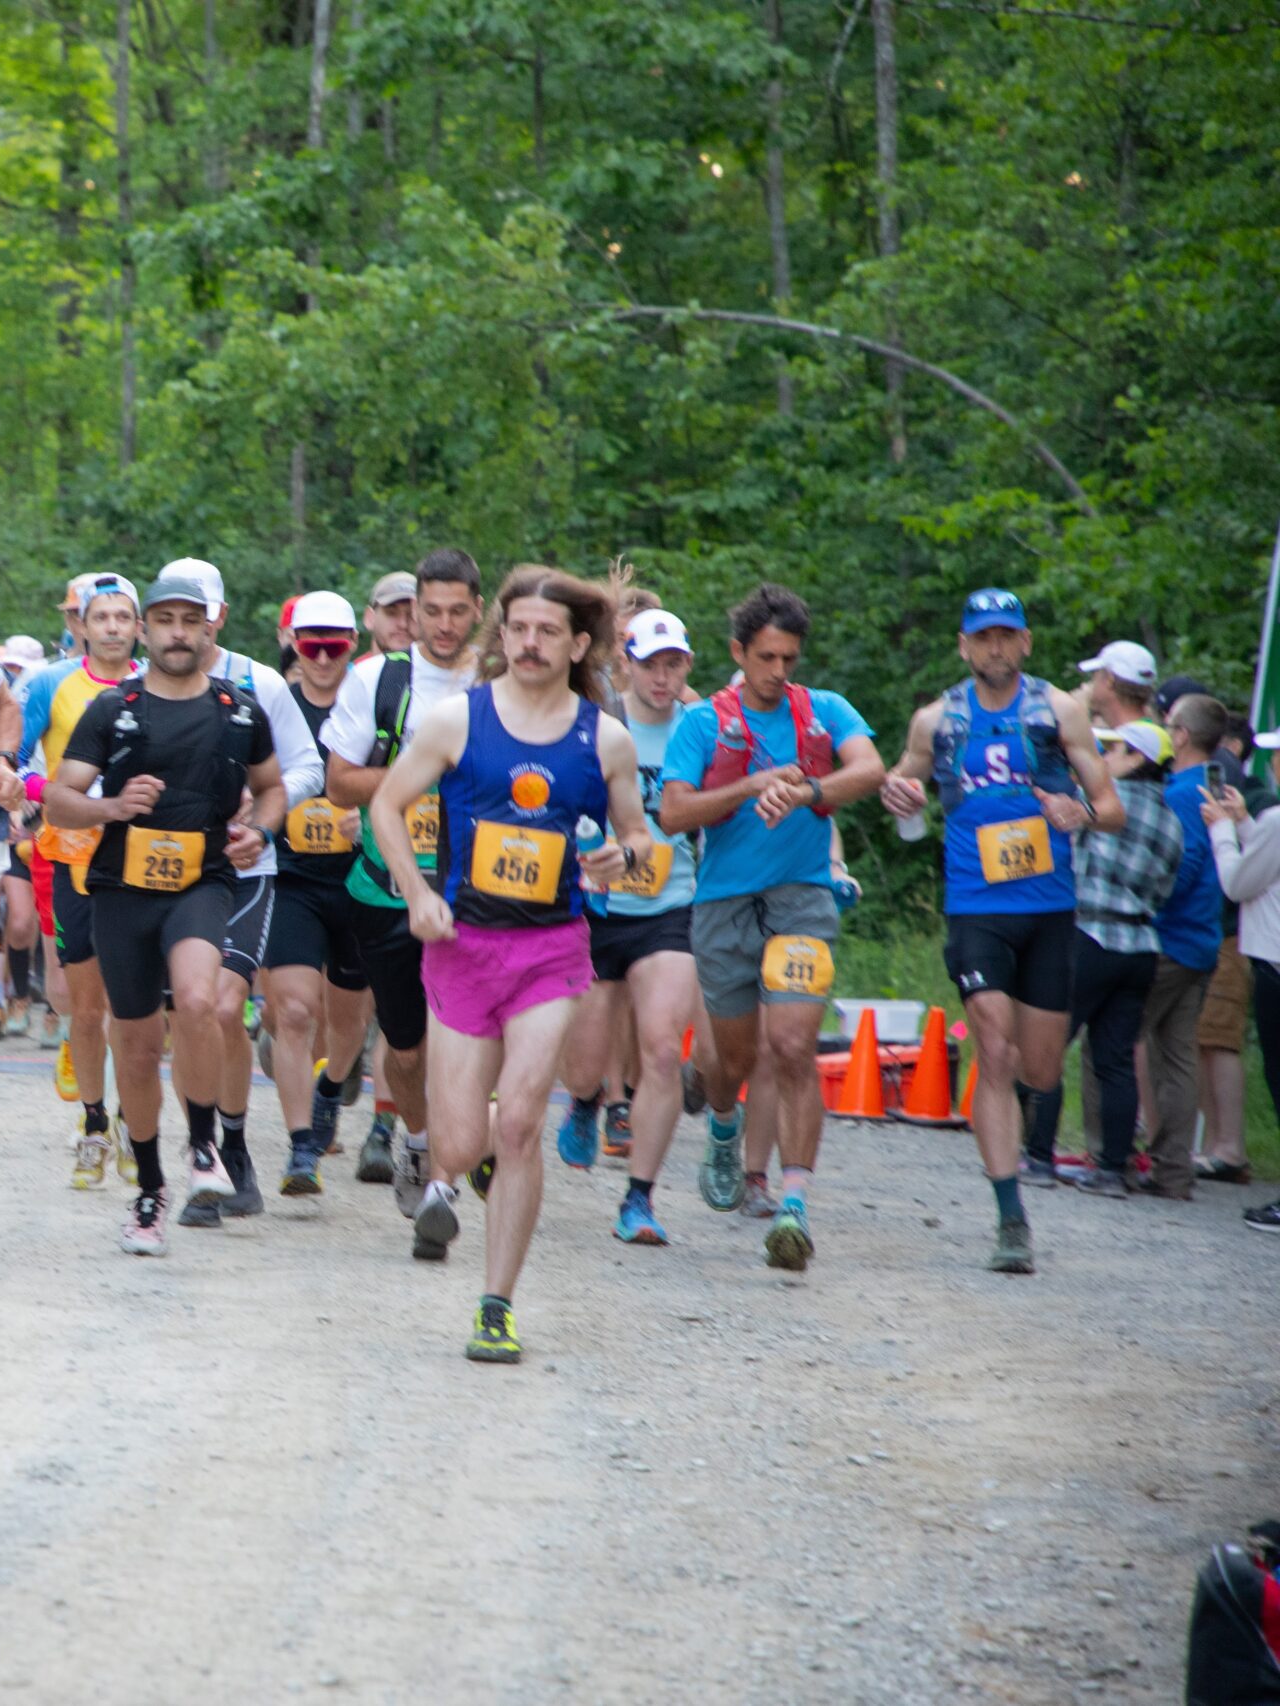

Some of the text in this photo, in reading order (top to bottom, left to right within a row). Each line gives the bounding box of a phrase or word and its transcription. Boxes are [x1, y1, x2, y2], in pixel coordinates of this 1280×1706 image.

[304, 822, 334, 842] 412
[999, 843, 1037, 866] 429
[144, 855, 184, 880] 243
[492, 856, 541, 887] 456
[784, 961, 816, 982] 411
